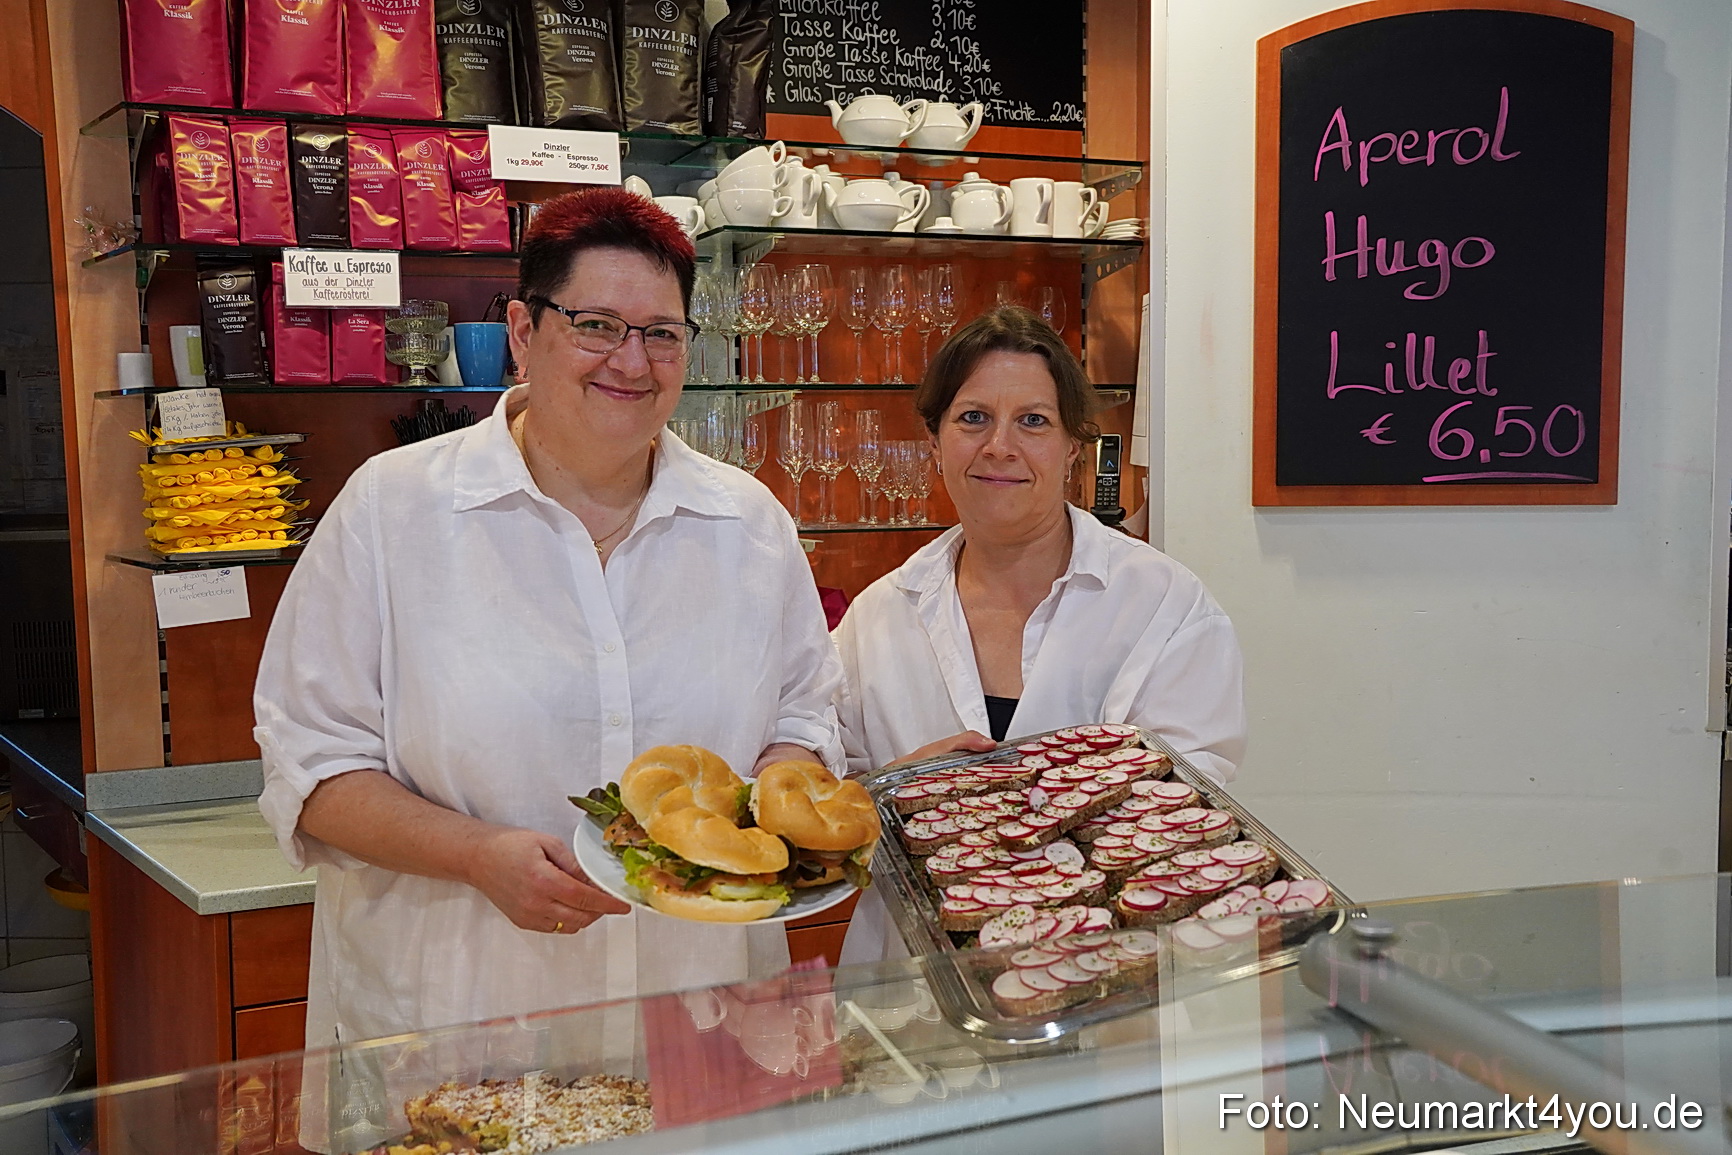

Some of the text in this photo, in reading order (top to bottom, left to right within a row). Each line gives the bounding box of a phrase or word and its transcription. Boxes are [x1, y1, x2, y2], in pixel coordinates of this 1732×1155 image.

[164, 9, 193, 20] Klassik
[932, 4, 977, 31] 3,10€
[281, 15, 309, 26] Klassik
[543, 13, 608, 34] DINZLER
[379, 24, 405, 34] Klassik
[436, 23, 506, 40] DINZLER
[551, 27, 606, 41] KAFFEERÖSTEREI
[632, 26, 698, 48] DINZLER
[779, 13, 981, 57] Tasse Kaffee 2,10€
[444, 37, 502, 48] KAFFEERÖSTEREI
[567, 49, 596, 58] DINZLER
[639, 42, 693, 56] KAFFEERÖSTEREI
[459, 56, 489, 64] DINZLER
[782, 37, 992, 76] Große Tasse Kaffee 4,20€
[464, 63, 486, 71] Verona
[651, 61, 680, 71] DINZLER
[655, 68, 676, 77] Verona
[782, 58, 1004, 97] Große Tasse Schokolade 3,10€
[785, 80, 822, 103] Glas
[825, 82, 854, 106] Tee
[1313, 86, 1522, 187] Aperol
[543, 143, 571, 151] Dinzler
[180, 152, 224, 161] DINZLER
[241, 156, 282, 167] DINZLER
[301, 156, 342, 165] DINZLER
[531, 151, 555, 159] Kaffee
[567, 153, 599, 162] Espresso
[353, 162, 393, 170] DINZLER
[406, 162, 447, 171] DINZLER
[506, 158, 609, 171] 1kg 29,90€ 250gr. 7,50€
[252, 177, 274, 185] Klassik
[1321, 210, 1496, 300] Hugo
[288, 255, 329, 276] Kaffee
[347, 257, 392, 276] Espresso
[302, 276, 375, 288] aus der Dinzler
[208, 294, 251, 303] DINZLER
[313, 287, 371, 300] Kaffeerösterei
[217, 316, 247, 324] DINZLER
[1326, 329, 1498, 399] Lillet
[1360, 400, 1586, 464] € 6.50
